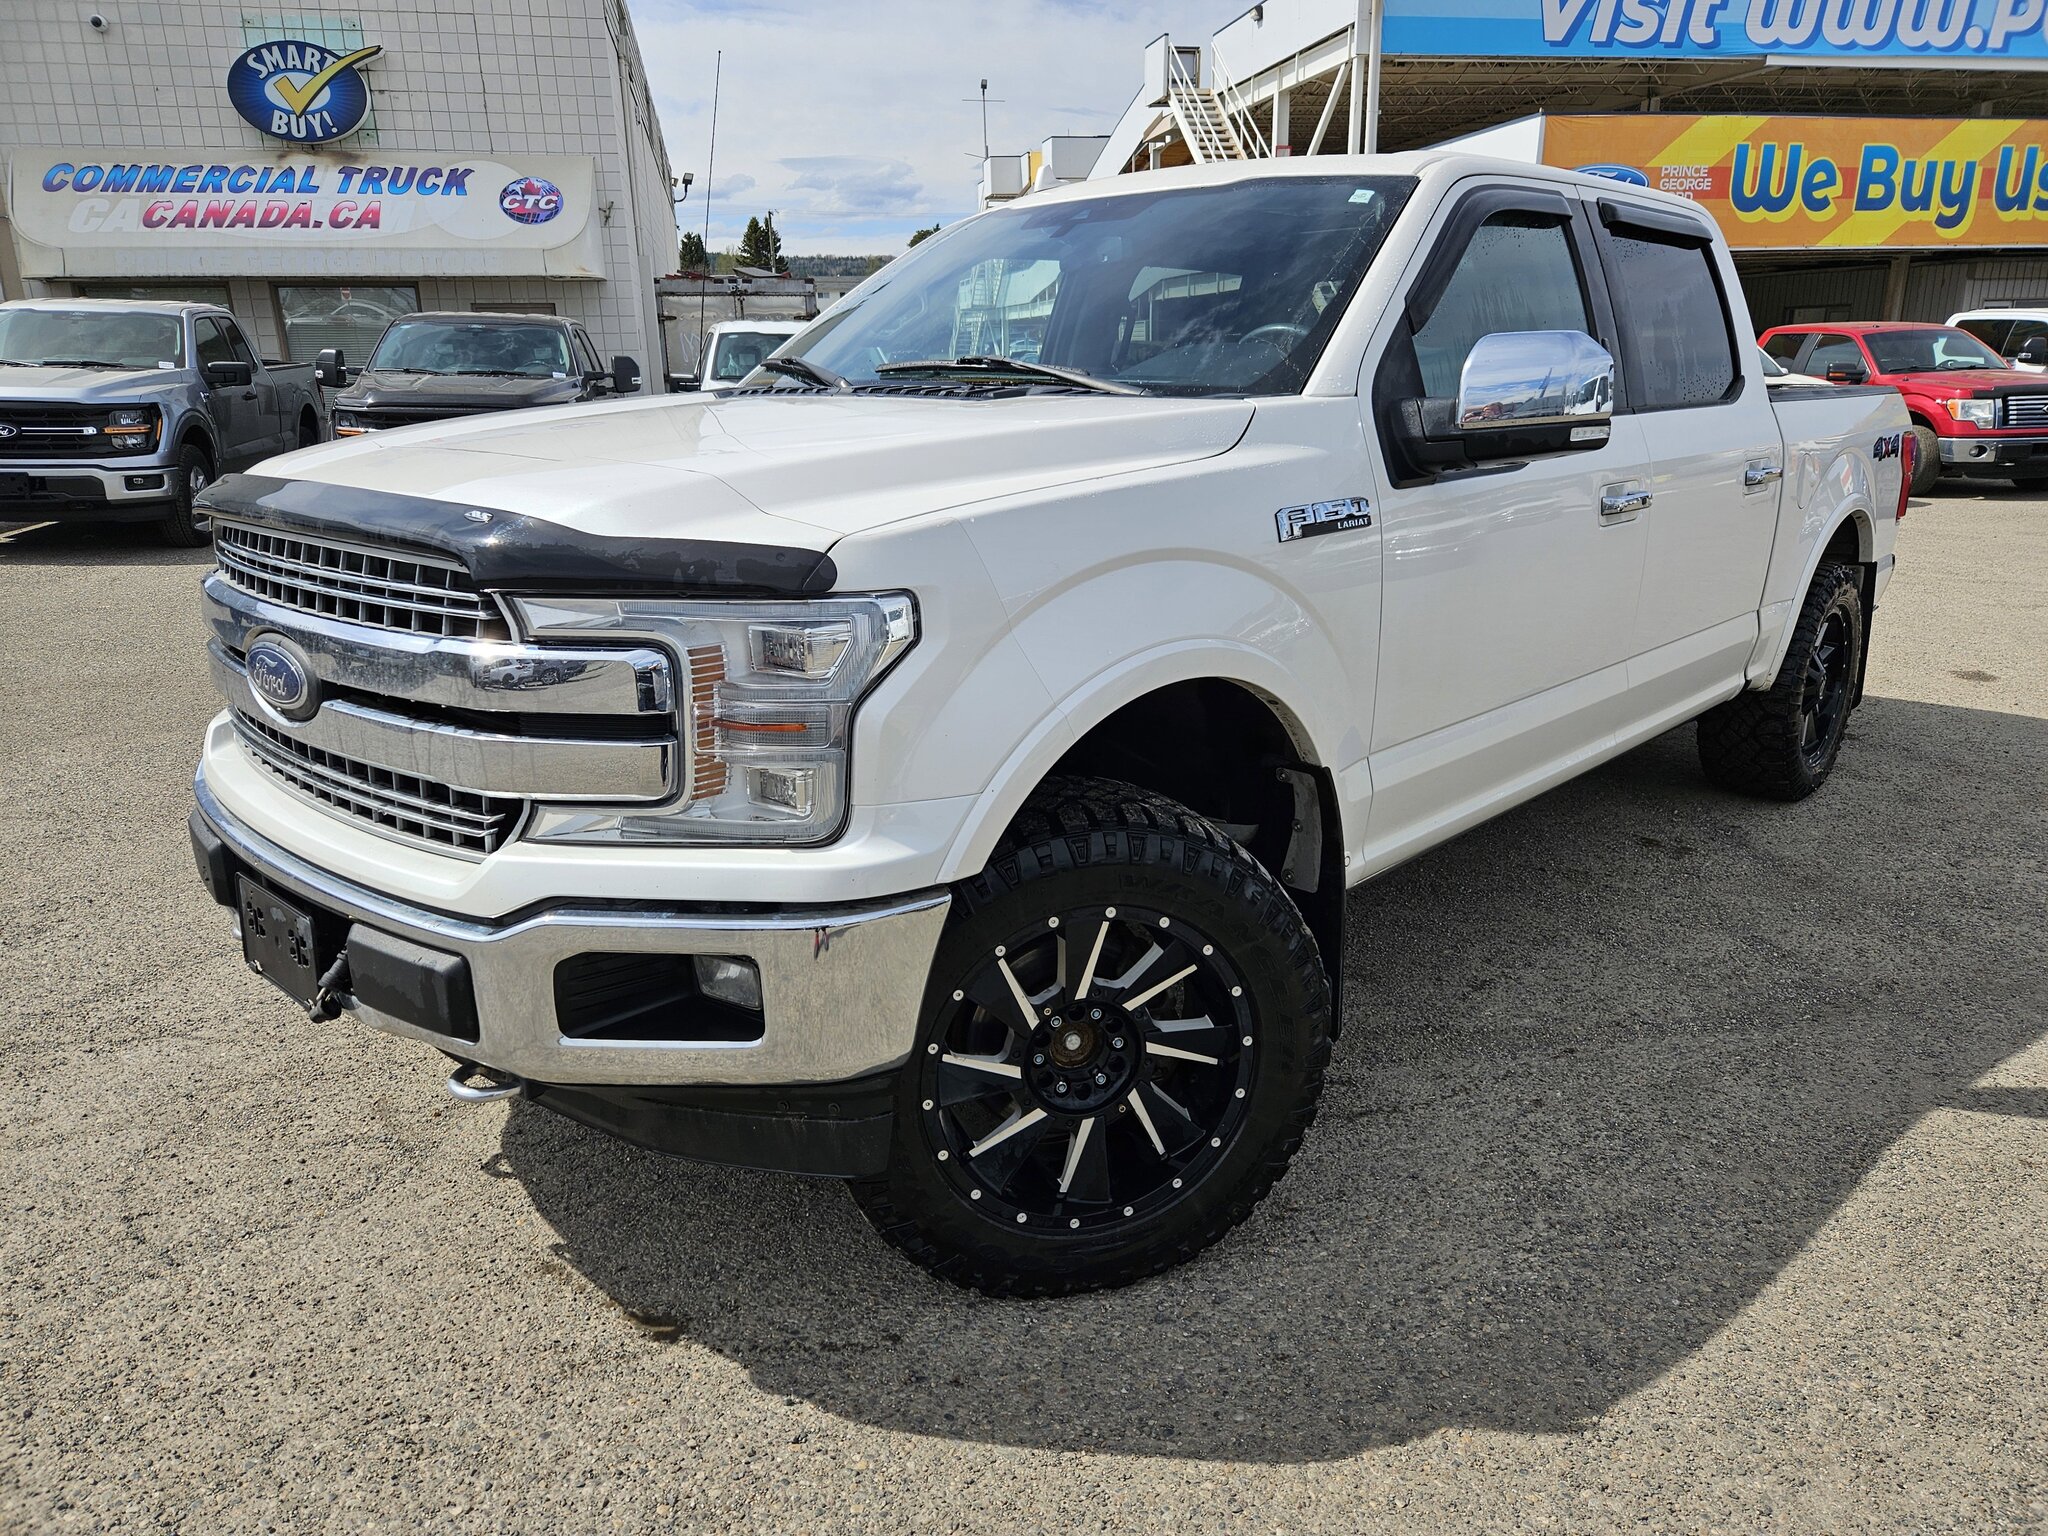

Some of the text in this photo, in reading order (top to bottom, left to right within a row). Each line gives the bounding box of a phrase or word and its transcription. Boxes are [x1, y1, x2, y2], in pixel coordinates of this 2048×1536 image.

[247, 45, 338, 79] SMART
[271, 110, 338, 138] BUY!
[42, 163, 475, 196] COMMERCIAL TRUCK
[1660, 178, 1712, 190] GEORGE
[1661, 165, 1709, 177] PRINCE
[1730, 143, 1837, 213] We
[1854, 144, 1977, 231] Buy
[142, 199, 381, 229] CANADA.CA
[502, 194, 558, 210] CTC
[1337, 517, 1369, 530] LARIAT
[253, 655, 287, 696] Ford
